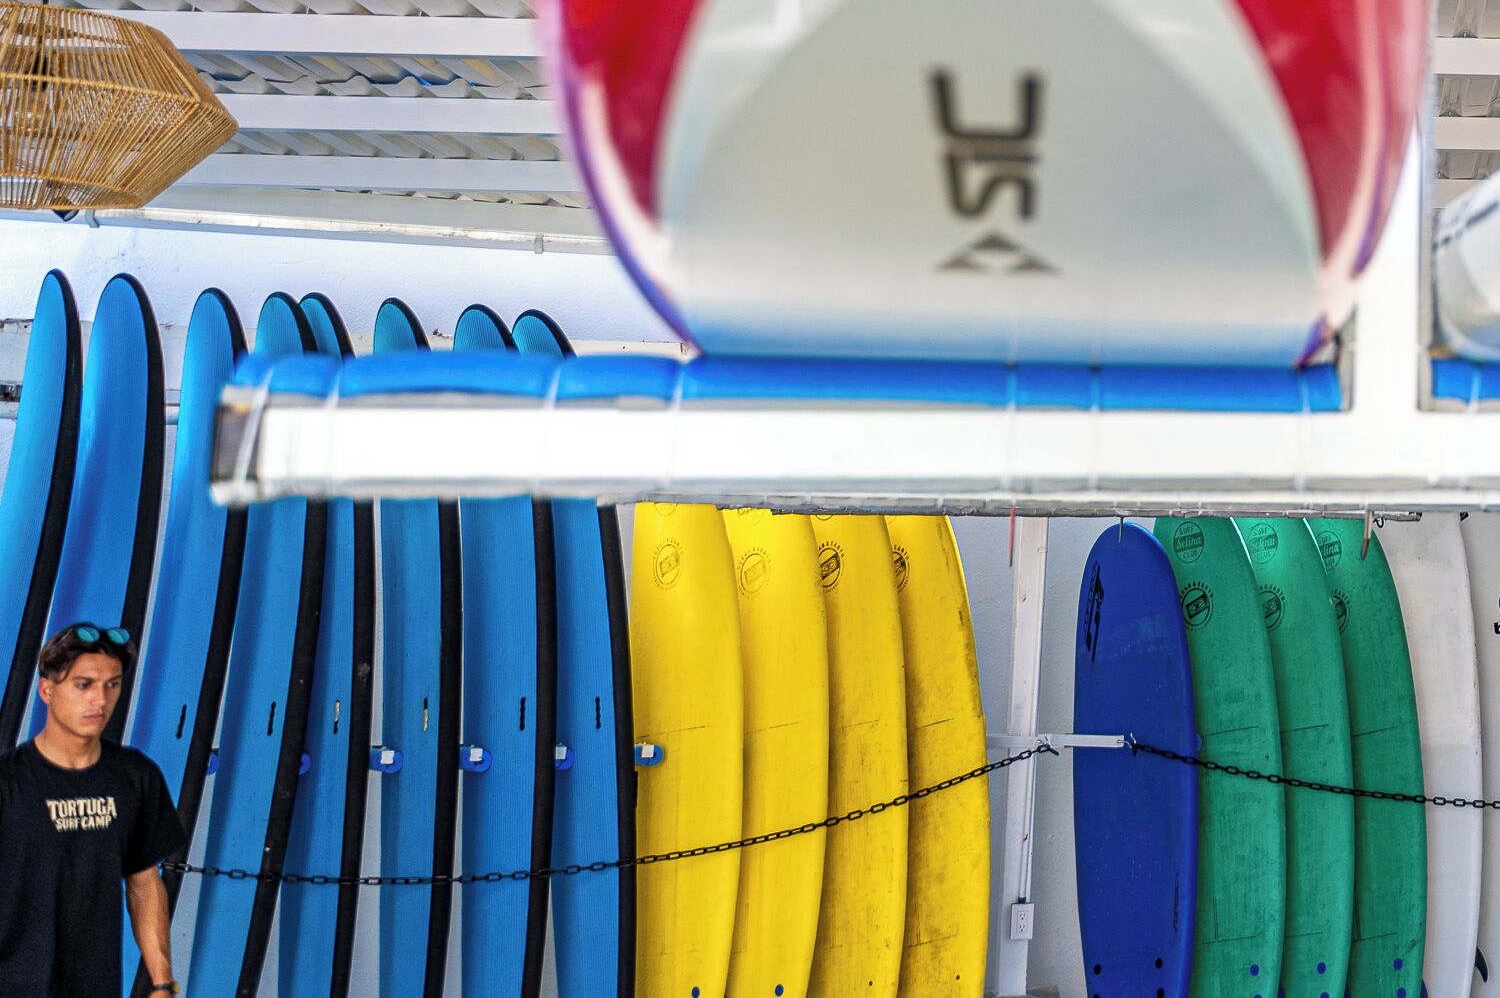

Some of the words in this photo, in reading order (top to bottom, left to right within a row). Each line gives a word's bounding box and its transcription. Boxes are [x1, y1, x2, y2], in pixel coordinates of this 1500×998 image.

[1176, 536, 1201, 550] Selina
[1322, 544, 1339, 556] lina
[46, 796, 118, 821] TORTUGA
[56, 817, 79, 833] SURF
[79, 814, 112, 831] CAMP
